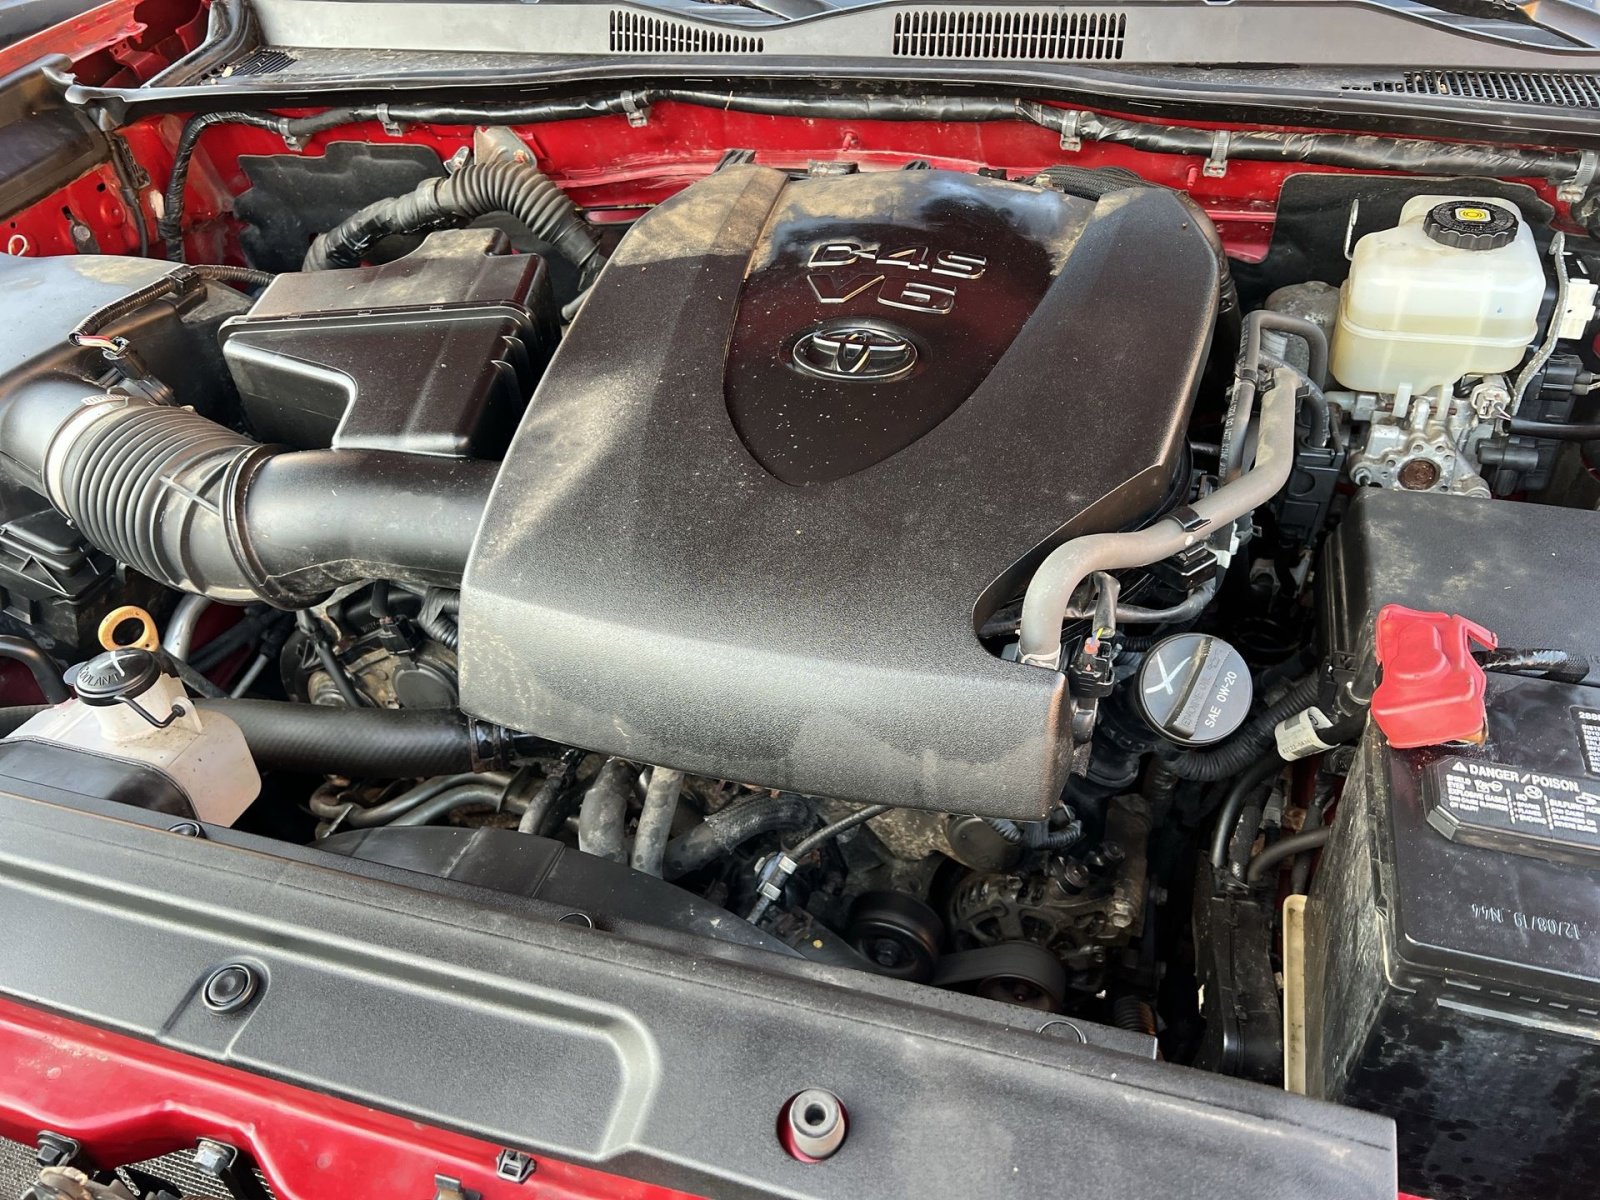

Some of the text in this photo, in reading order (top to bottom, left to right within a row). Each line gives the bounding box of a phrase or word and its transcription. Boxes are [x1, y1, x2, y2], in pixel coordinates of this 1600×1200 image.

[808, 243, 987, 280] D-4S
[807, 274, 957, 314] V6
[1204, 670, 1238, 728] SAE 0W-20
[1468, 763, 1520, 783] DANGER
[1515, 793, 1528, 802] NO
[1549, 799, 1585, 811] SULFURIC
